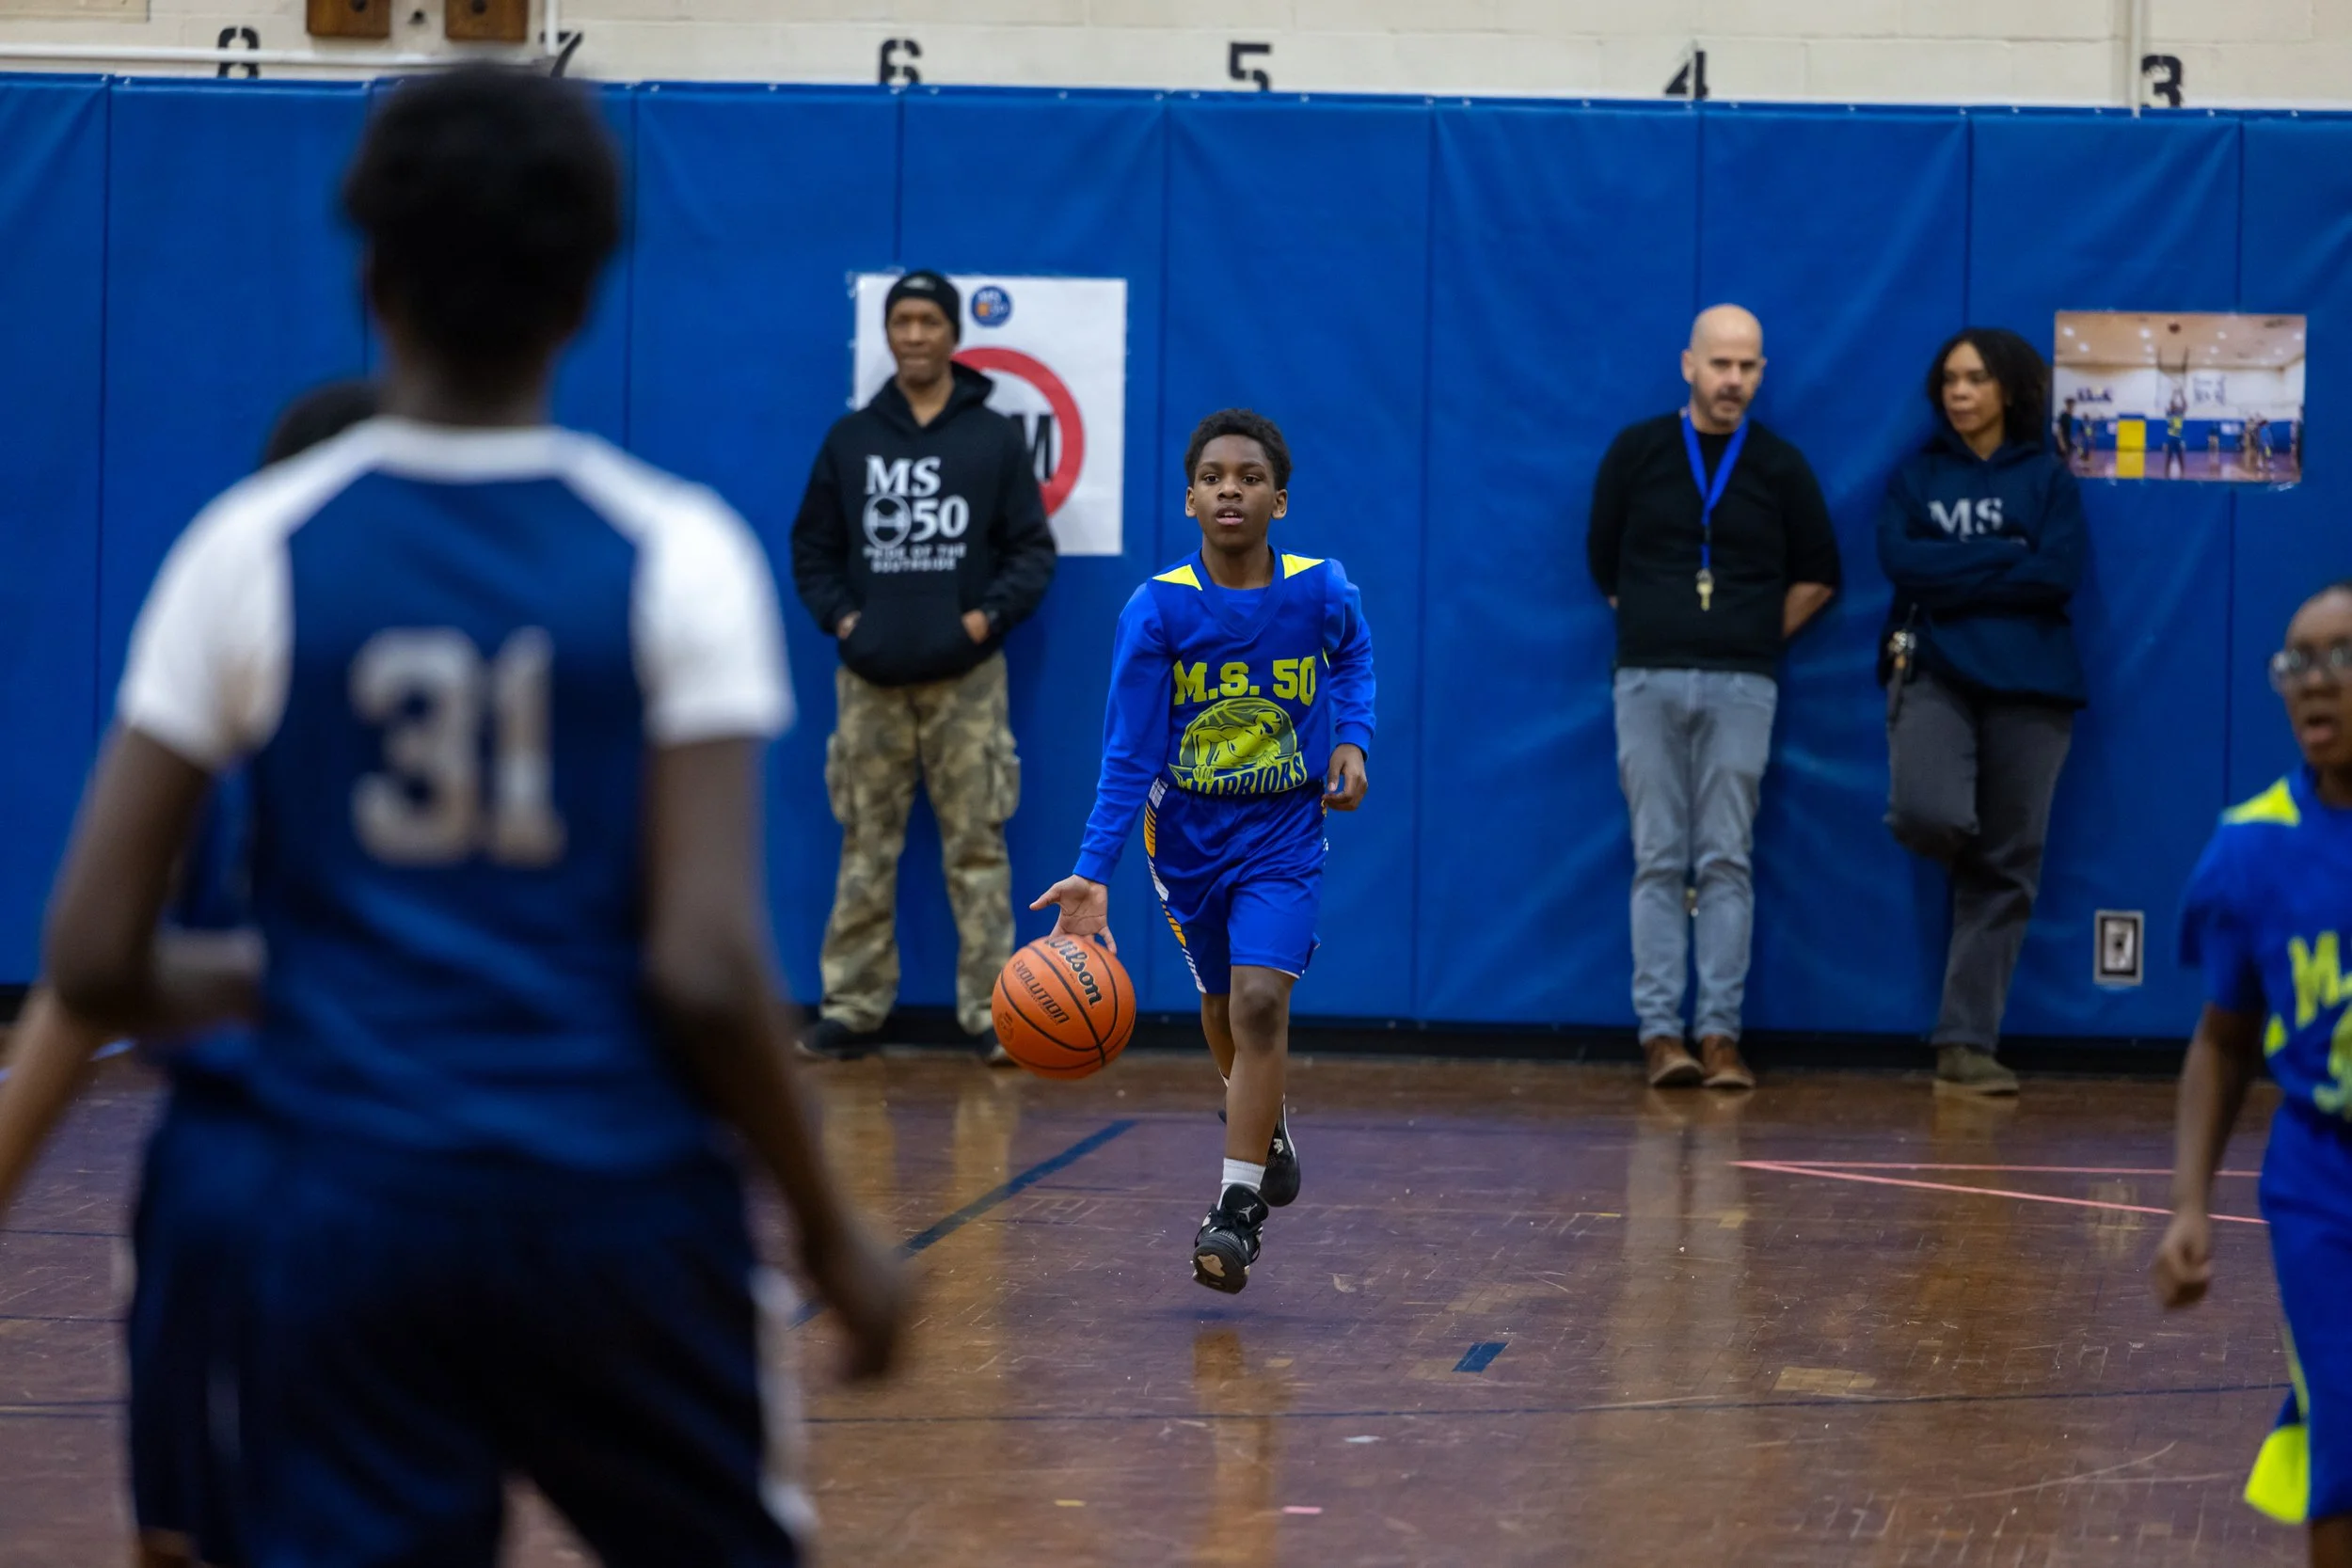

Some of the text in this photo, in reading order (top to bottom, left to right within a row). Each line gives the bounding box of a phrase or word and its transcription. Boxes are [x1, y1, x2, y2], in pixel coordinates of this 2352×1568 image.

[539, 30, 582, 78] 7
[879, 39, 921, 85] 6
[1228, 41, 1270, 91] 5
[1662, 50, 1709, 99] 4
[2141, 54, 2183, 108] 3
[865, 454, 942, 498] MS
[910, 495, 970, 543] 50
[1927, 497, 2003, 535] MS
[1173, 656, 1316, 705] M.S. 50
[347, 623, 568, 870] 31
[1013, 959, 1070, 1023] EVOLUTION
